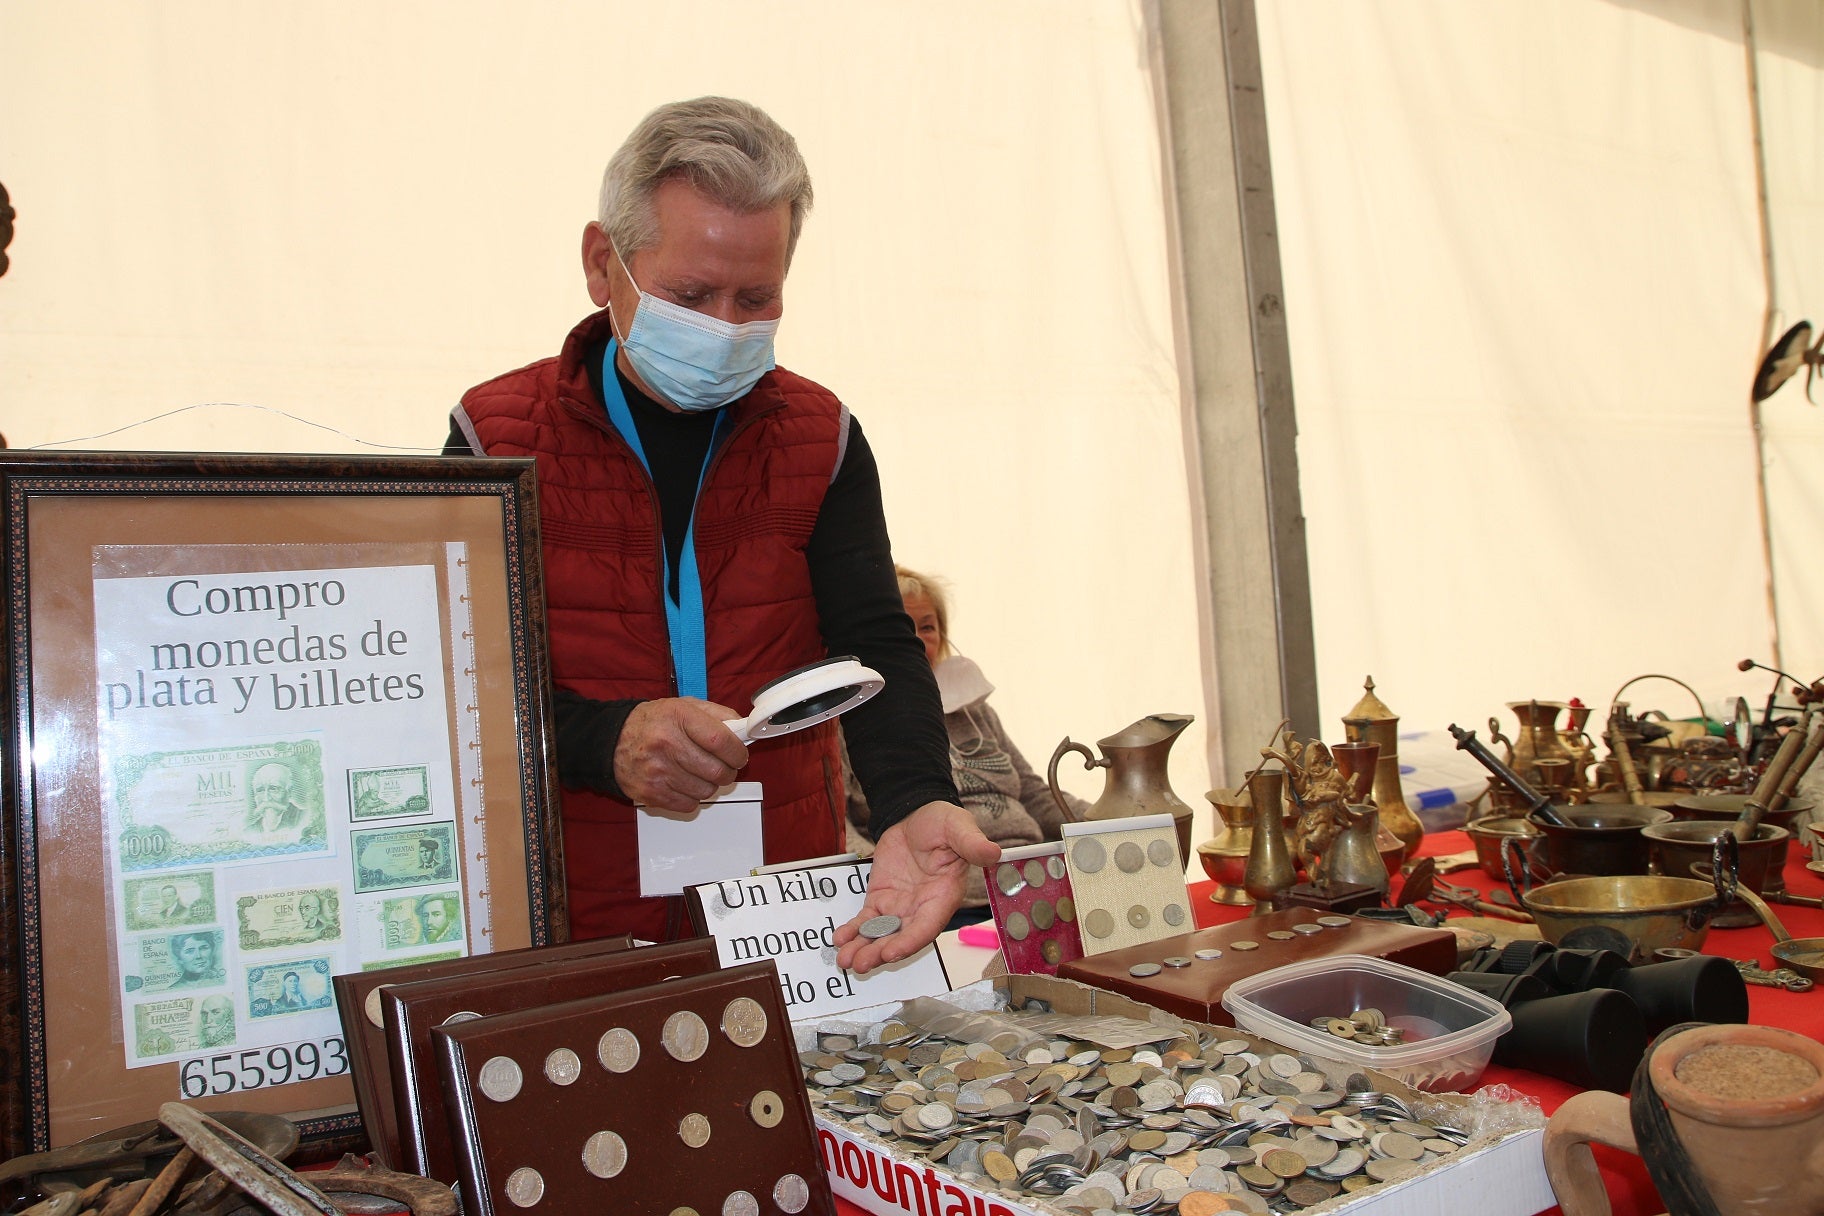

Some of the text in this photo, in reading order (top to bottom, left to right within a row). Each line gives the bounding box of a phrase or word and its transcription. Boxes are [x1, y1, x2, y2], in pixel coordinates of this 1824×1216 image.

[166, 579, 345, 620] Compro
[150, 619, 408, 671] monedas de
[105, 668, 425, 719] plata y billetes
[716, 879, 770, 909] Un
[775, 870, 838, 903] kilo
[142, 938, 166, 946] BANCO
[729, 916, 836, 961] moned
[782, 968, 855, 1006] do el
[181, 1038, 349, 1098] 655993
[816, 1126, 1015, 1216] mounta
